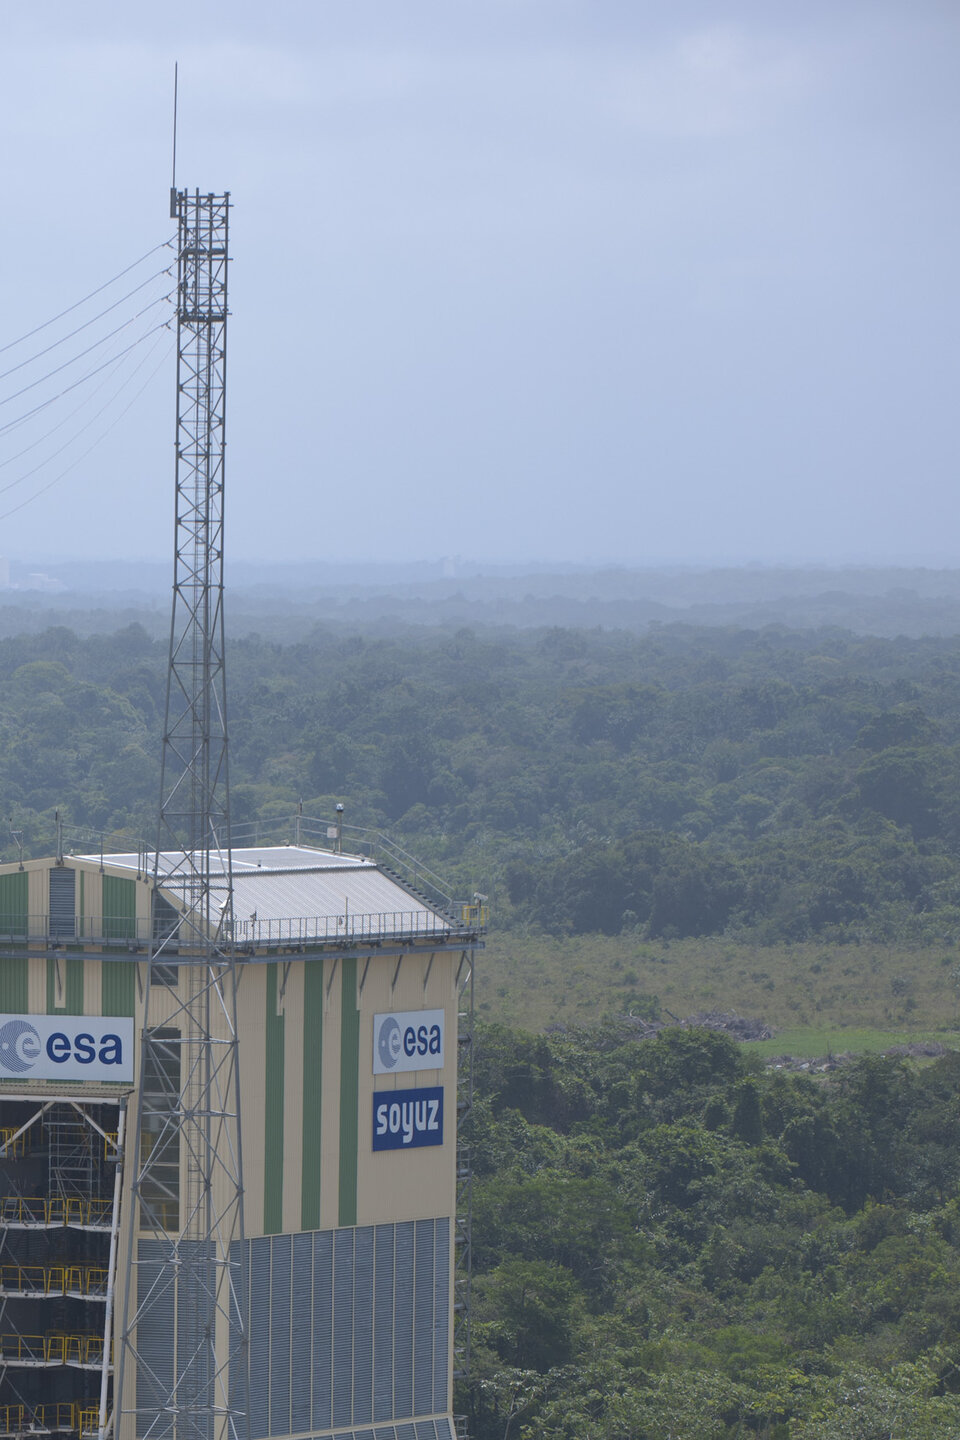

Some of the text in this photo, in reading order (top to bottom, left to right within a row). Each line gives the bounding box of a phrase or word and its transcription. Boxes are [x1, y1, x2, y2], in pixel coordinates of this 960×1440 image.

[46, 1032, 123, 1065] esa
[403, 1024, 441, 1057] esa
[376, 1099, 439, 1144] soyuz
